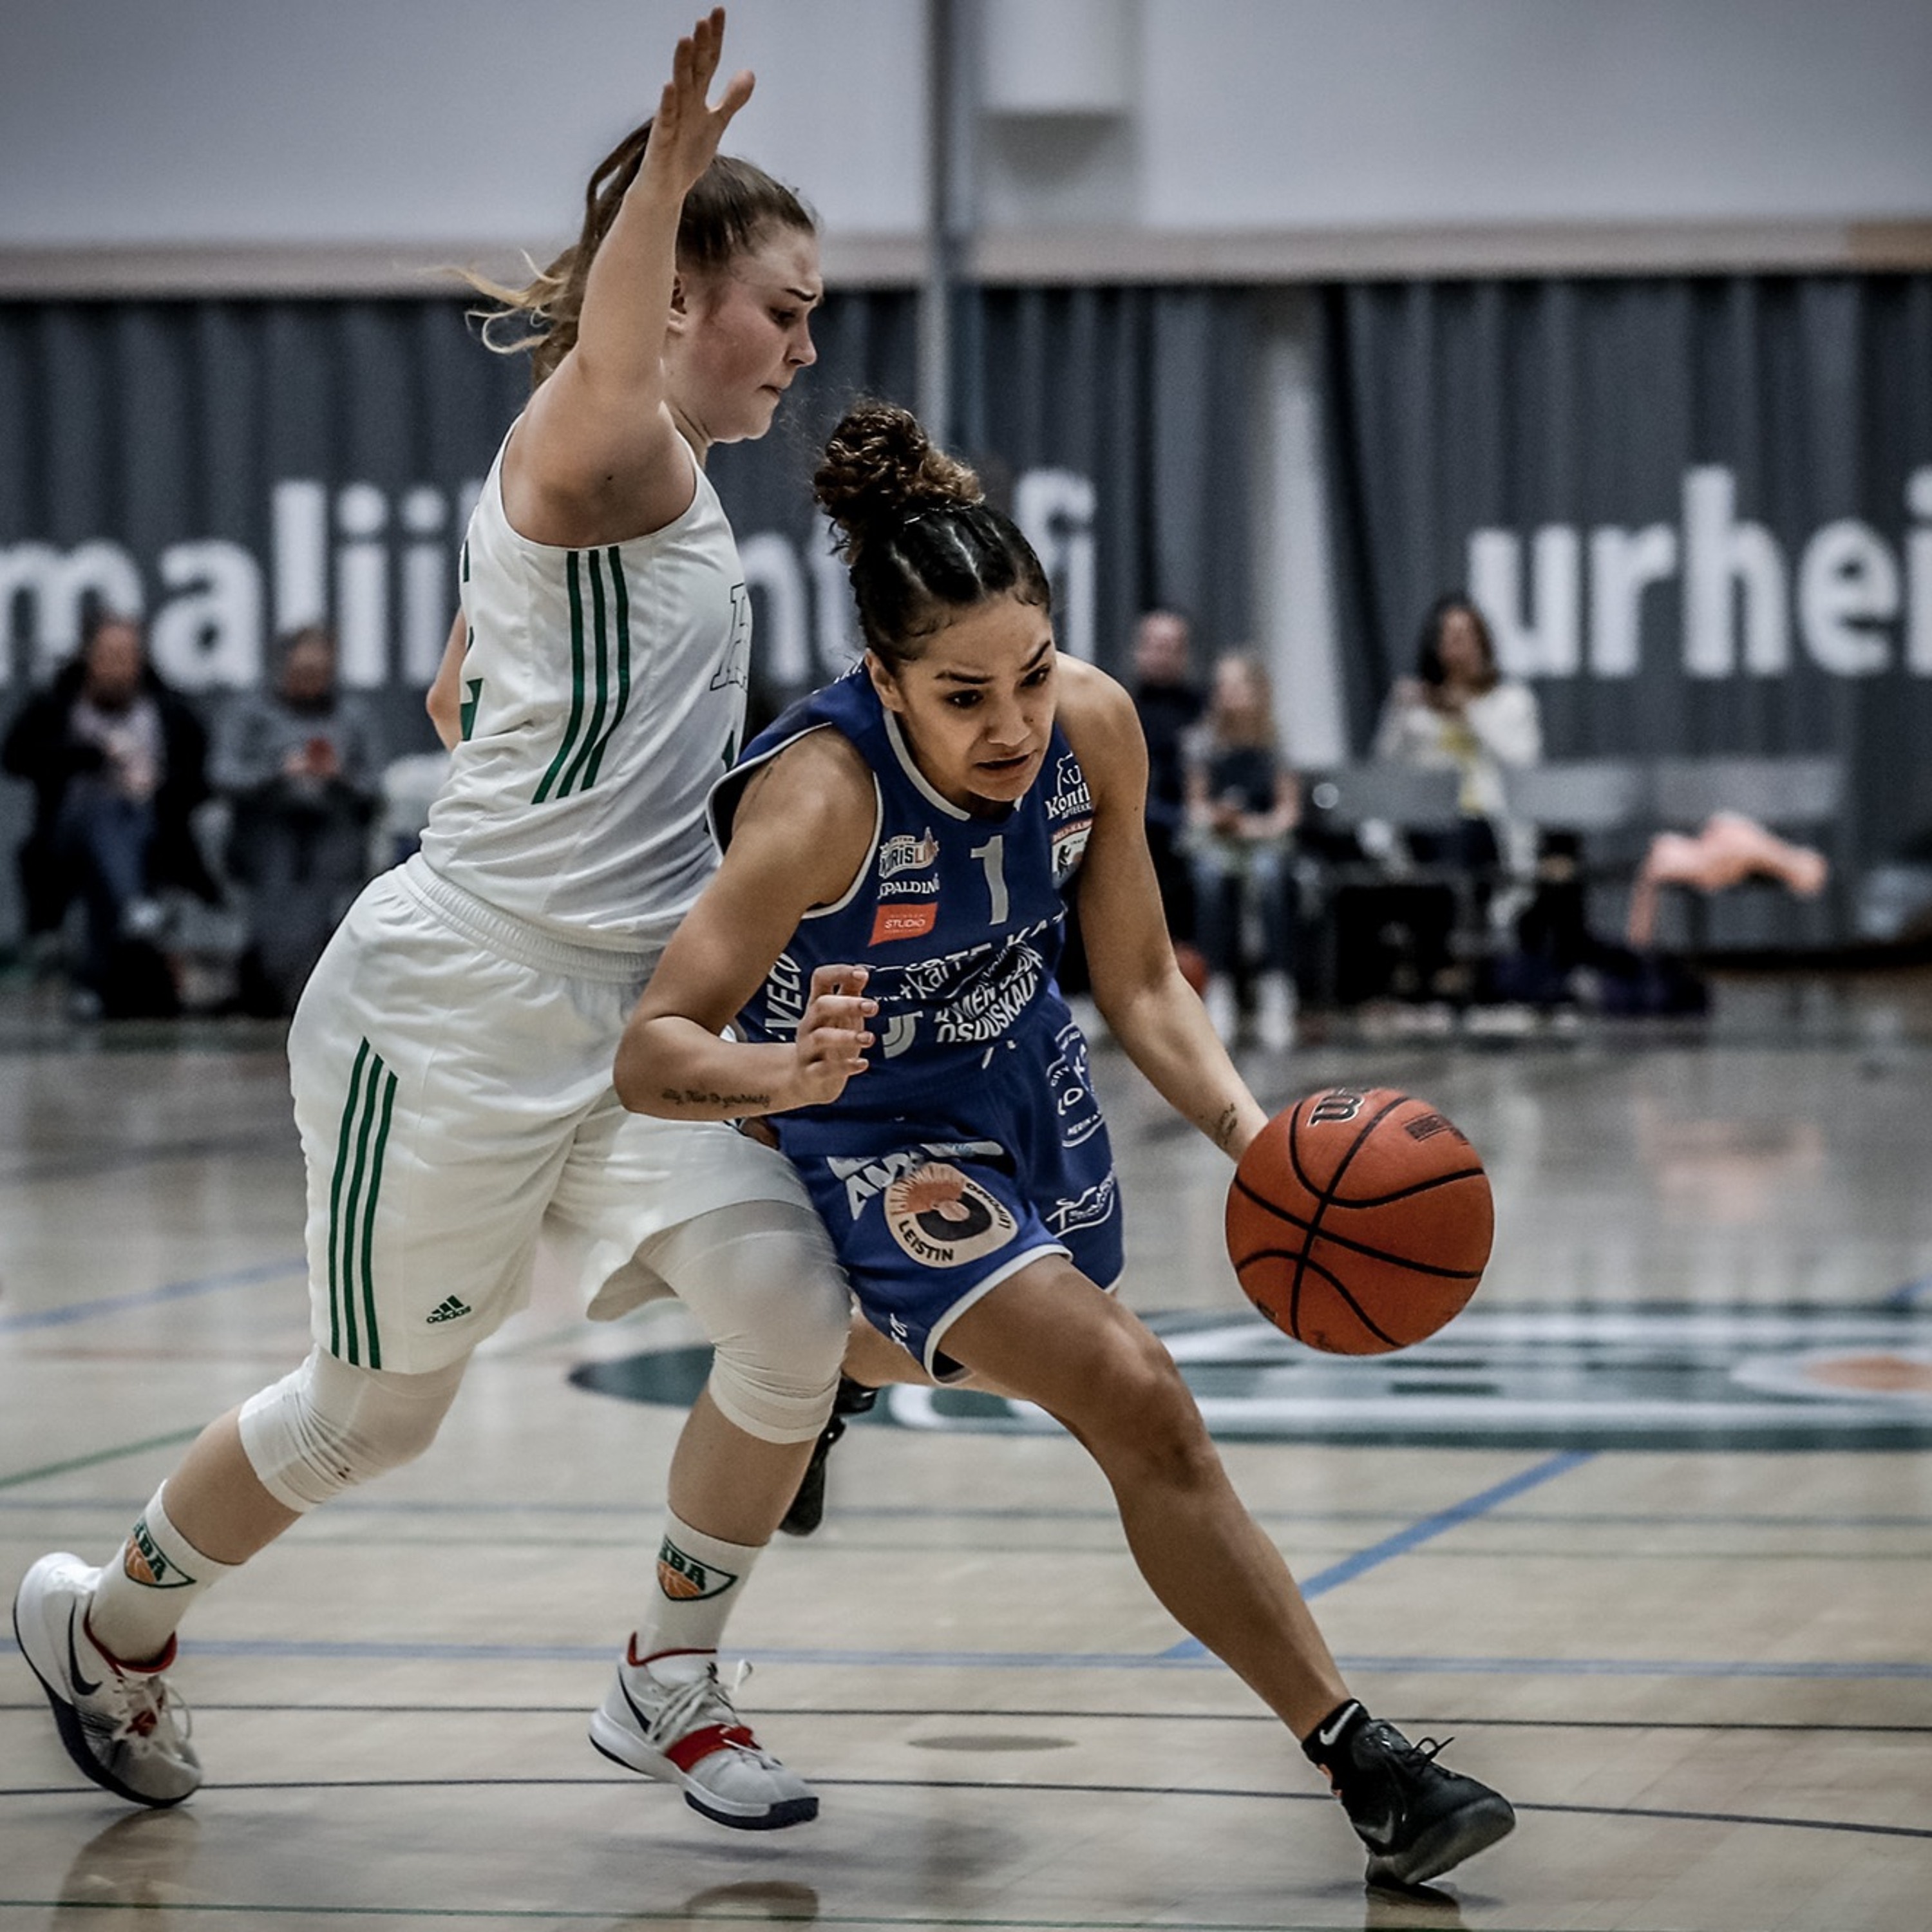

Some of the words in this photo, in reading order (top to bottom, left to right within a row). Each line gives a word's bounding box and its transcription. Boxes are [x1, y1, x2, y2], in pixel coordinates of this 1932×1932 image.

[971, 835, 1009, 925] 1
[884, 919, 926, 929] STUDIO
[898, 1220, 954, 1262] LEISTIN
